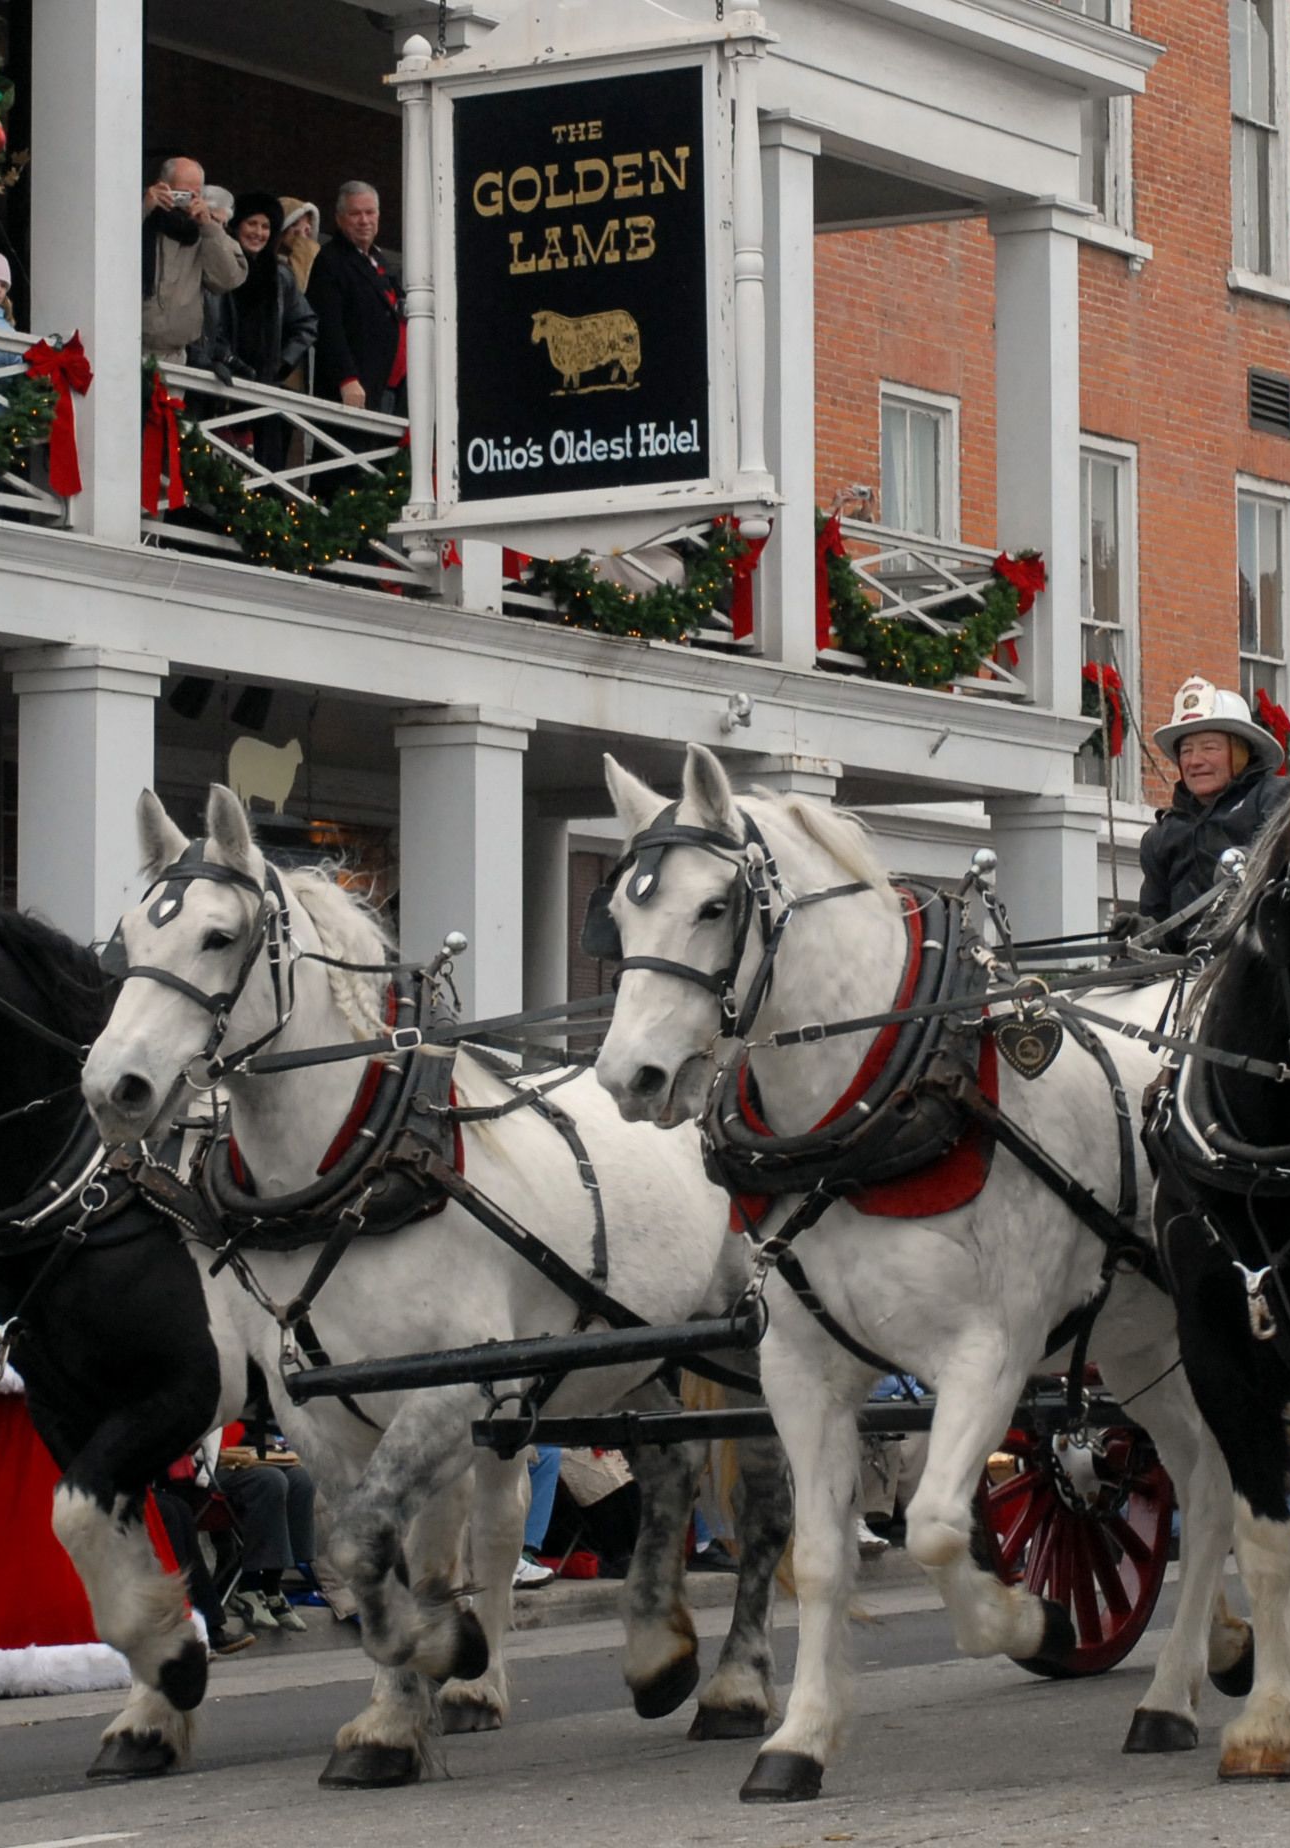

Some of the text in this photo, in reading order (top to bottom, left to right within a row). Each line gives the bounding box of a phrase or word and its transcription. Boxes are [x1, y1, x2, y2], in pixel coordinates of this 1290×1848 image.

[552, 120, 603, 144] THE
[472, 146, 691, 217] GOLDEN
[509, 215, 657, 275] LAMB
[467, 418, 700, 475] Ohio's Oldest Hotel
